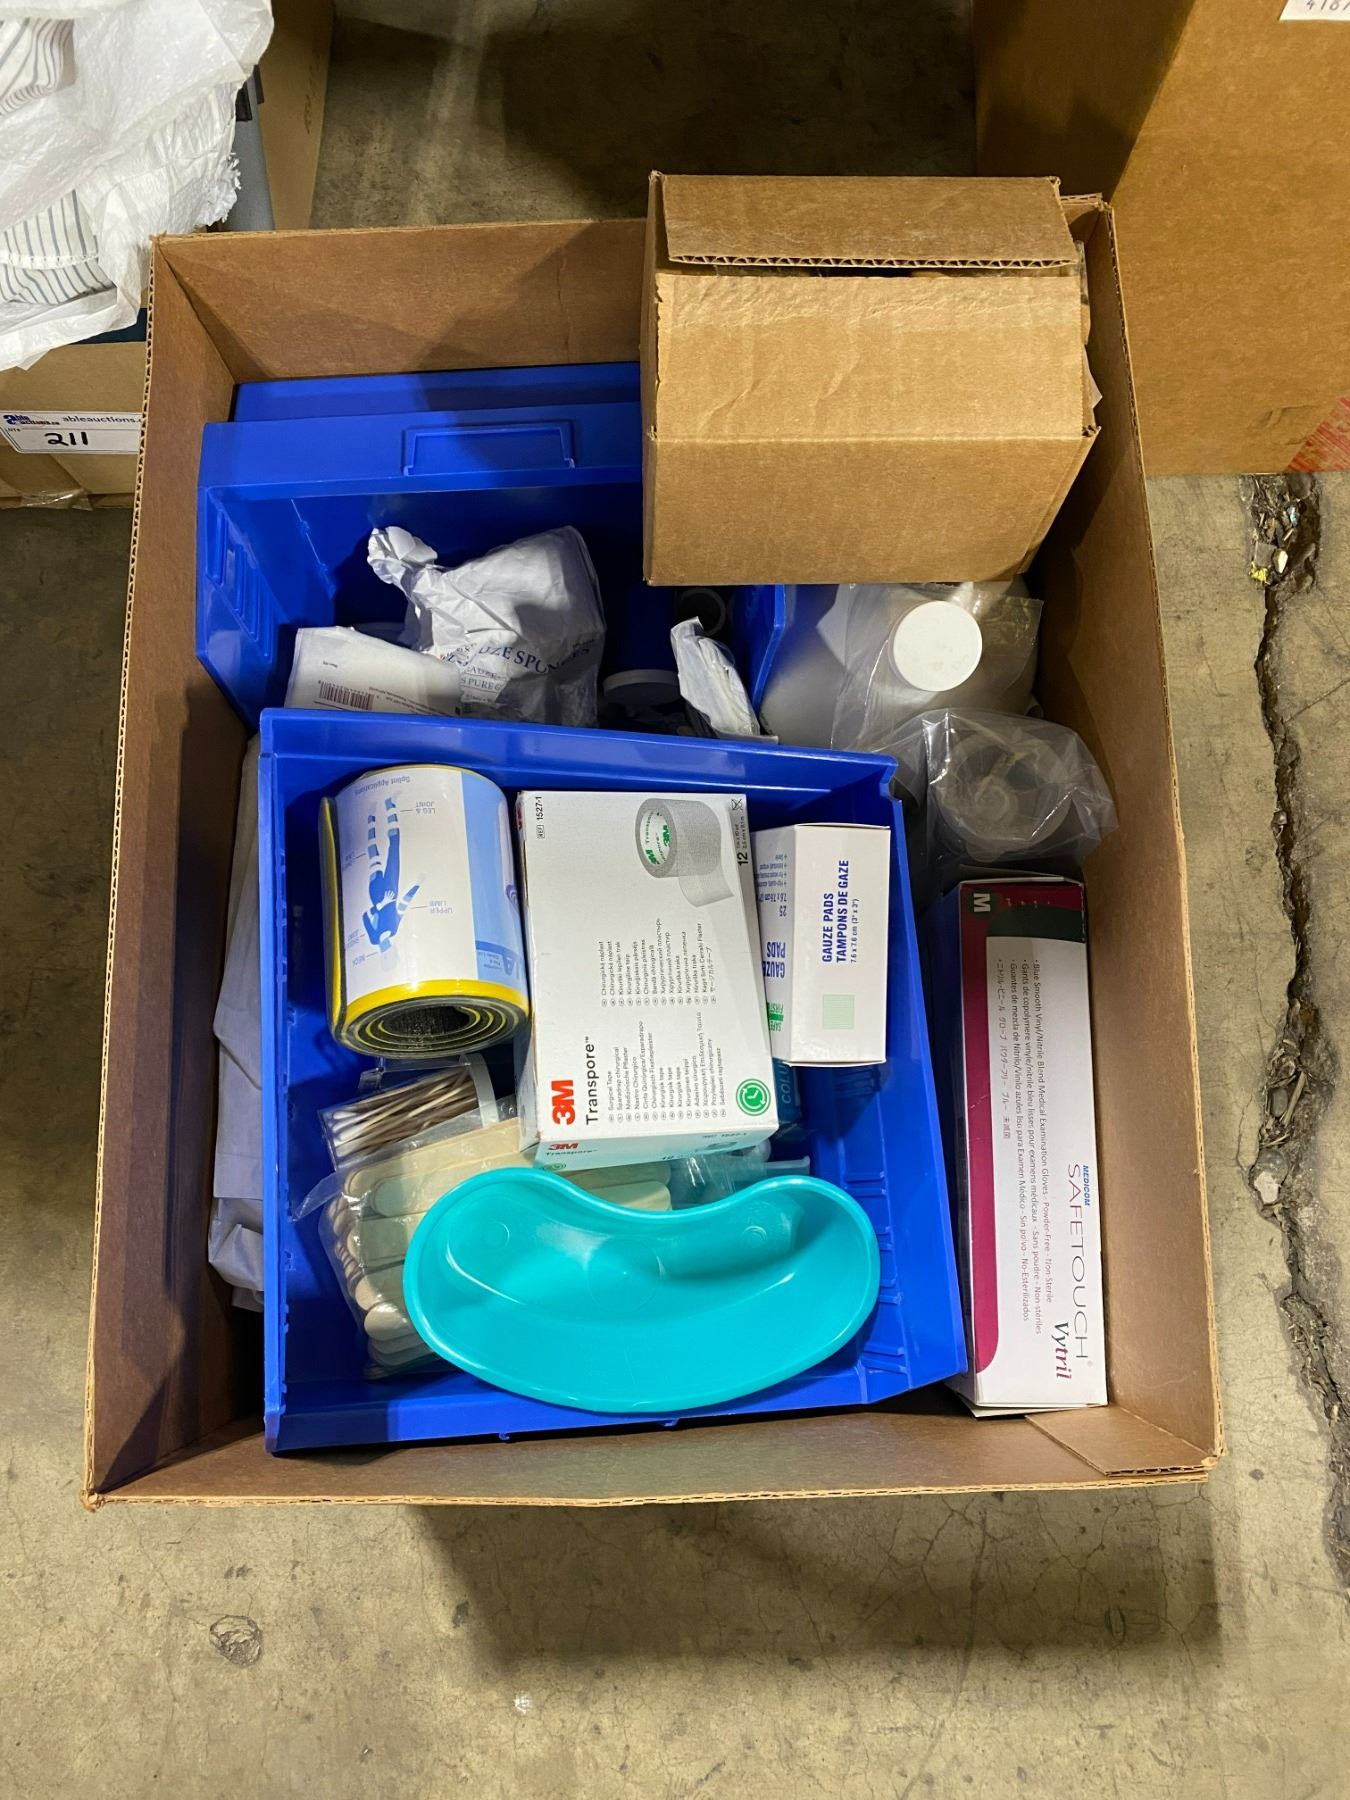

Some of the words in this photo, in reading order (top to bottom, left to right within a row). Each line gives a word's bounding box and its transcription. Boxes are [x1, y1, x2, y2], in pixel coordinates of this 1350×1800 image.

[44, 431, 88, 446] 211
[535, 796, 543, 821] 1527-1
[737, 852, 748, 866] 12
[838, 860, 849, 888] GAZE
[823, 893, 834, 922] PADS
[838, 891, 848, 905] DE
[974, 892, 990, 912] M
[822, 926, 833, 962] GAUZE
[837, 908, 848, 963] TAMPONS
[852, 926, 858, 936] cm
[767, 942, 786, 958] PADS
[1010, 963, 1018, 993] Guantes
[1022, 963, 1030, 984] Gants
[1011, 994, 1018, 1003] de
[1023, 986, 1030, 995] de
[1034, 982, 1042, 1011] Smooth
[1012, 1006, 1020, 1030] mezcla
[1012, 1032, 1020, 1041] de
[1033, 1013, 1044, 1060] Vinyl/Nitrile
[1013, 1043, 1022, 1090] Nitrilo/Vinilo
[1025, 1042, 1034, 1088] vinyle/nitrile
[1037, 1061, 1045, 1083] Blend
[551, 1080, 575, 1125] 3M
[1016, 1091, 1024, 1114] azules
[1027, 1090, 1035, 1107] bleu
[1038, 1085, 1047, 1116] Medical
[548, 1142, 579, 1150] 3M
[1016, 1130, 1024, 1147] para
[1027, 1130, 1035, 1148] pour
[1039, 1118, 1048, 1166] Examination
[1017, 1148, 1025, 1178] Examen
[1041, 1168, 1050, 1195] Gloves
[1031, 1186, 1039, 1222] médicaux
[1043, 1202, 1051, 1251] Powder-Free
[1020, 1229, 1028, 1251] polvo
[1032, 1231, 1040, 1249] Sans
[1032, 1251, 1041, 1279] poudre
[1021, 1258, 1030, 1322] No-Esterilizados
[1045, 1258, 1053, 1303] Non-Sterile
[1051, 1322, 1072, 1379] Vytril
